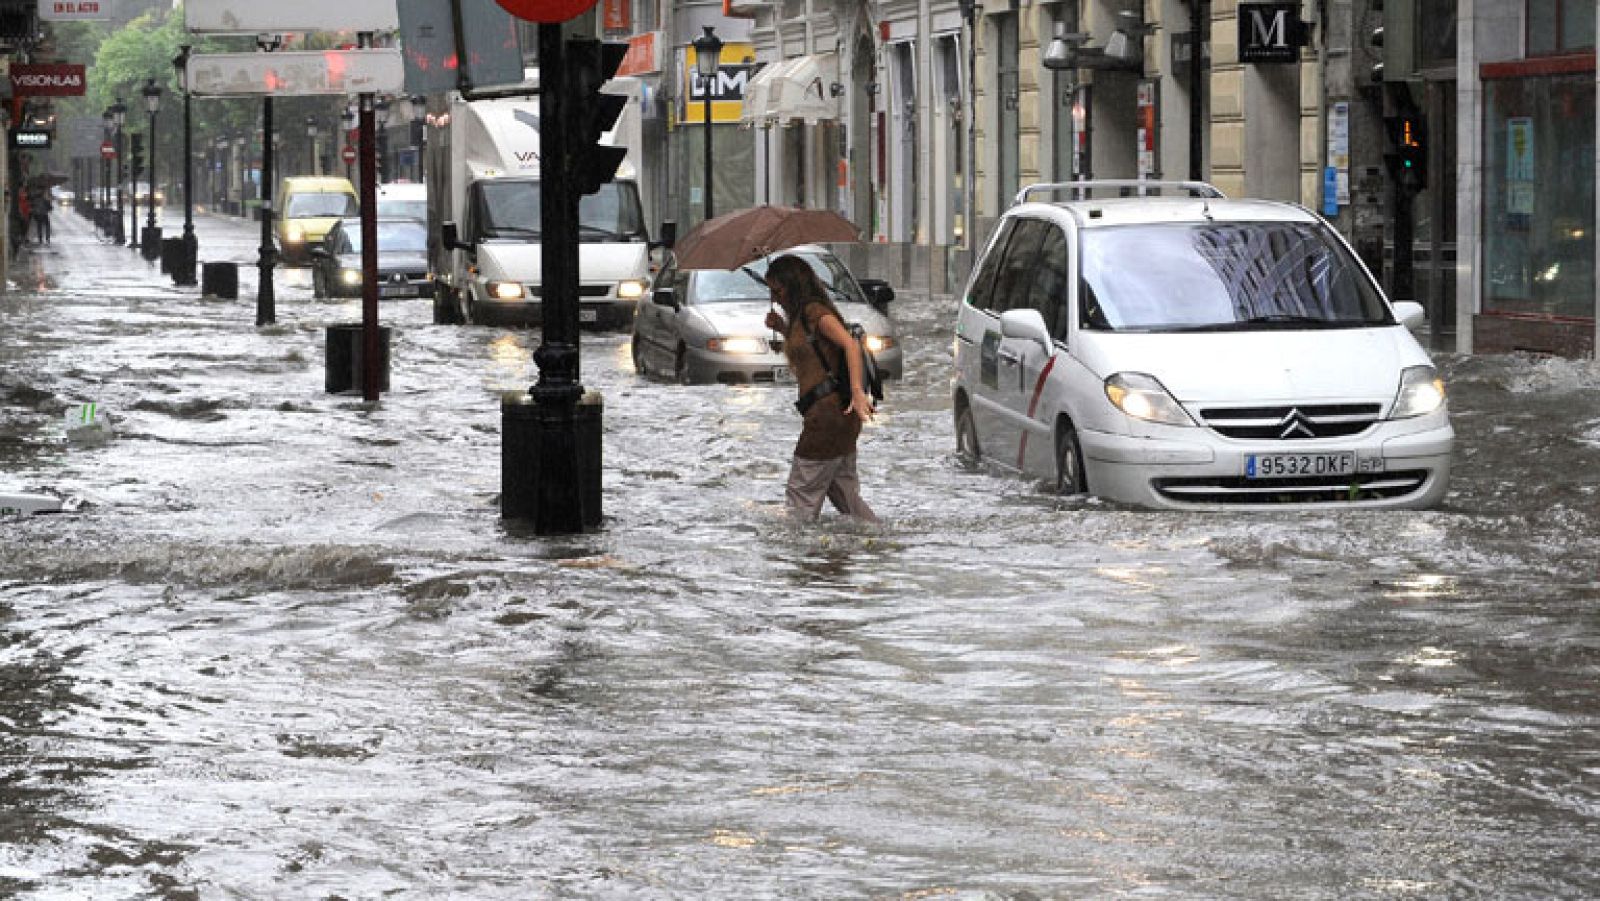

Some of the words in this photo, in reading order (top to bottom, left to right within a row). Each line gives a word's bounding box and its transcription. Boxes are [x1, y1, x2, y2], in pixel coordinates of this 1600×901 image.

[1248, 10, 1289, 48] M
[12, 74, 81, 87] VISIONLAB
[1261, 456, 1311, 475] 9532
[1315, 455, 1350, 474] DKF
